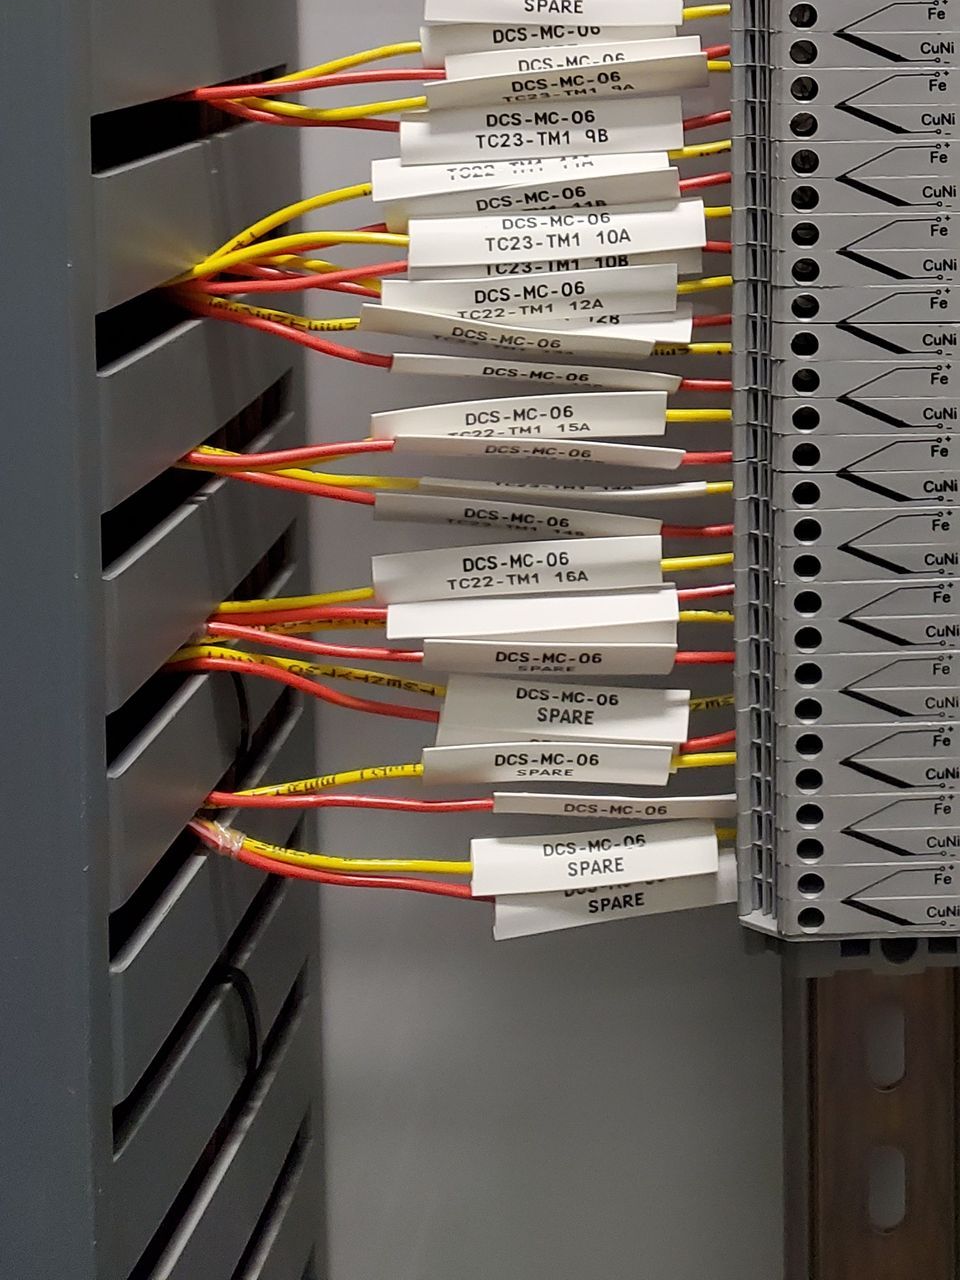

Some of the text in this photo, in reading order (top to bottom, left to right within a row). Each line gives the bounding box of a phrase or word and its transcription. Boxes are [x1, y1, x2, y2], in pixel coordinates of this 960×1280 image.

[512, 71, 621, 93] DCS-MC-06
[486, 110, 595, 127] DCS-MC-06
[476, 128, 608, 149] TC23-TM1 9B
[930, 152, 948, 163] Fe
[476, 186, 586, 212] DCS-MC-06
[922, 186, 956, 198] CuNi
[485, 229, 631, 252] TC23-TM1 10A
[475, 281, 585, 304] DCS-MC-06
[931, 372, 948, 384] Fe
[466, 405, 574, 426] DCS-MC-06
[923, 408, 957, 420] CuNi
[932, 519, 950, 531] Fe
[463, 552, 570, 572] DCS-MC-06
[924, 554, 958, 566] CuNi
[447, 571, 588, 590] TC22-TM1 16A
[516, 687, 619, 706] DCS-MC-06
[537, 708, 594, 725] SPARE
[933, 734, 951, 746] Fe
[495, 753, 599, 766] DCS-MC-06
[926, 768, 959, 780] CuNi
[568, 858, 624, 876] SPARE
[934, 873, 952, 884] Fe
[588, 893, 645, 913] SPARE
[927, 906, 960, 918] CuNi
